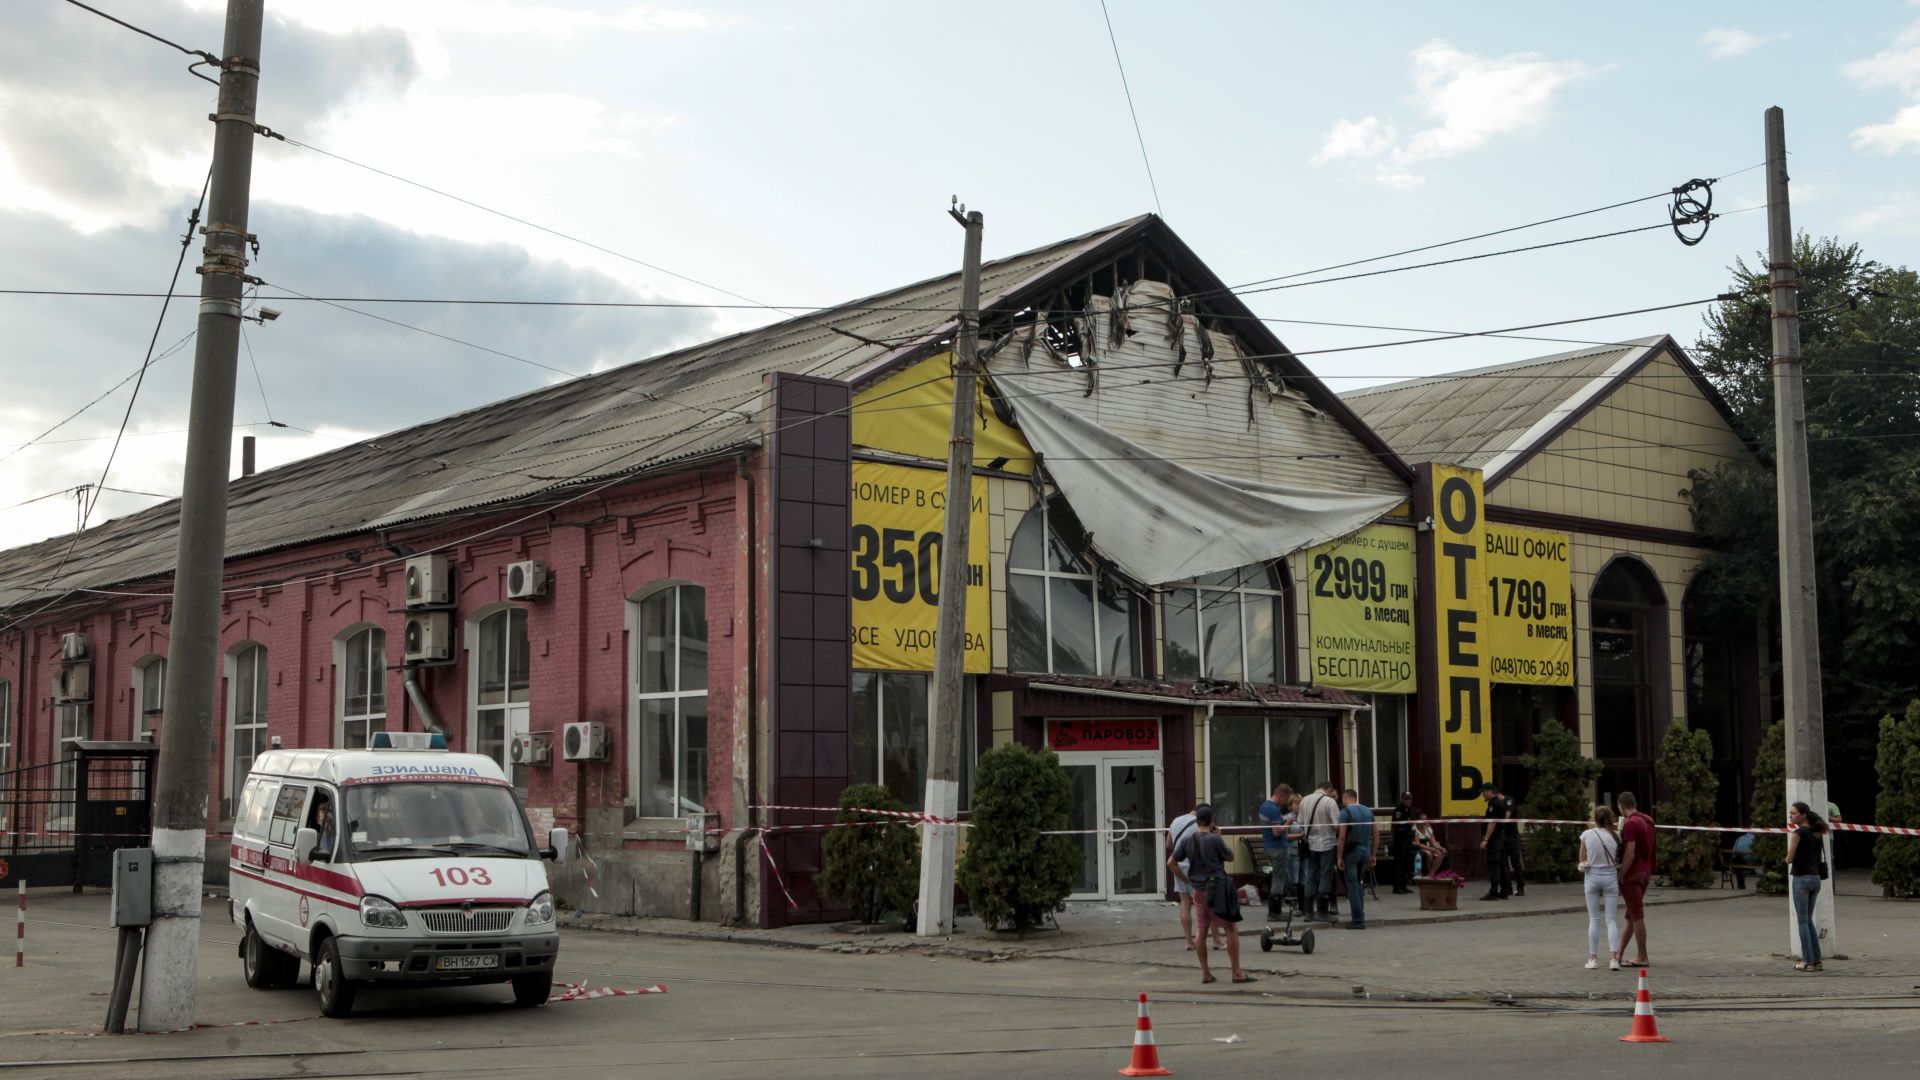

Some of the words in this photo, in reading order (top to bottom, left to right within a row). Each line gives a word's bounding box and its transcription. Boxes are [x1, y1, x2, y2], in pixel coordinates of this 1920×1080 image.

[916, 489, 925, 507] В
[1377, 540, 1410, 552] душем
[1486, 533, 1518, 556] ВАШ
[1524, 538, 1566, 561] ОФИС
[852, 523, 943, 606] 350
[1314, 554, 1386, 603] 2999
[1390, 584, 1408, 600] грн
[1489, 576, 1546, 620] 1799
[1550, 603, 1566, 618] грн
[1374, 607, 1410, 626] месяц
[1440, 477, 1484, 800] ОТЕЛЬ
[1536, 624, 1567, 641] месяц
[1317, 636, 1410, 655] КОММУНАЛЬНЫЕ
[1318, 657, 1411, 680] БЕСПЛАТНО
[1491, 656, 1536, 677] (048)706
[1540, 661, 1553, 676] 20
[1556, 661, 1569, 676] 30
[1083, 729, 1154, 740] ПАРОВОЗ
[429, 867, 492, 887] 103
[444, 957, 458, 968] BH
[461, 957, 480, 967] 1567
[483, 956, 496, 966] CX
